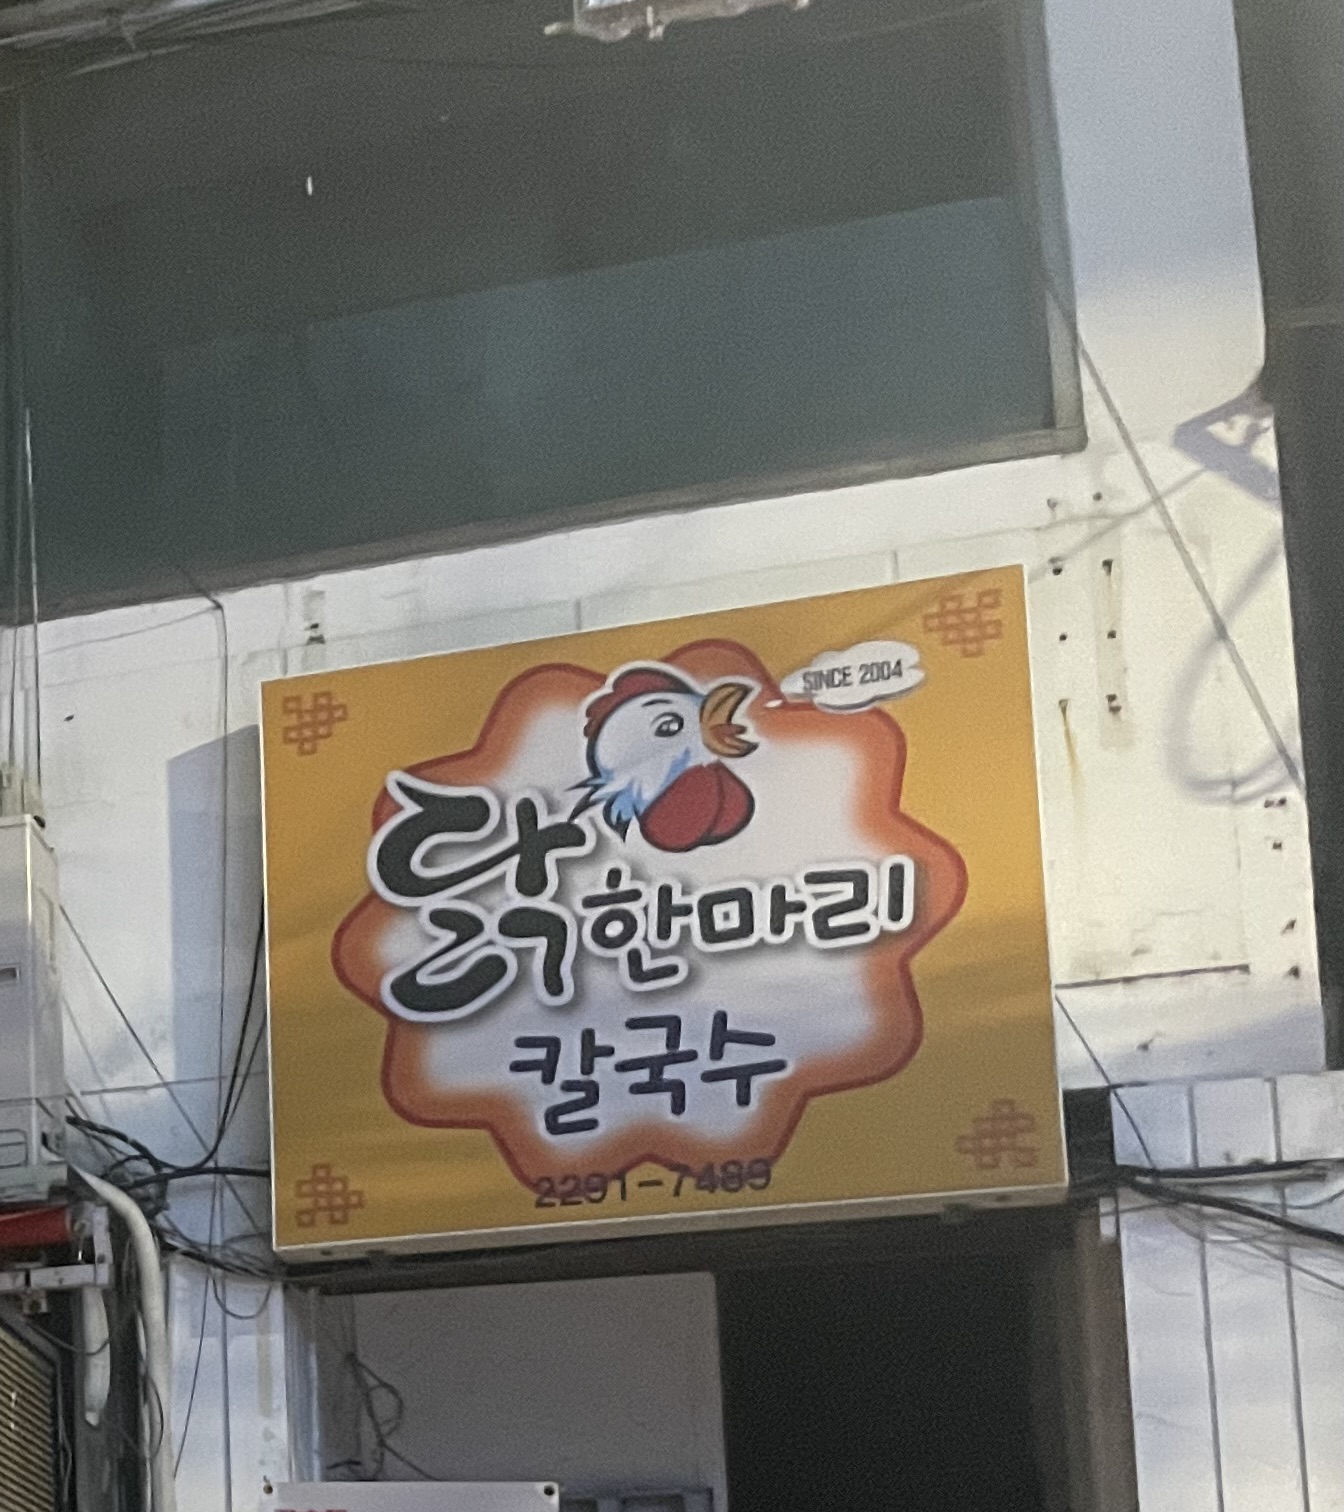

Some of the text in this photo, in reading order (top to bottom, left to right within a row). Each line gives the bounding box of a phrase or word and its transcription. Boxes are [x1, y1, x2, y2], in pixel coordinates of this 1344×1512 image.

[802, 660, 904, 693] SINCE 2004
[510, 1010, 788, 1136] 칼국수
